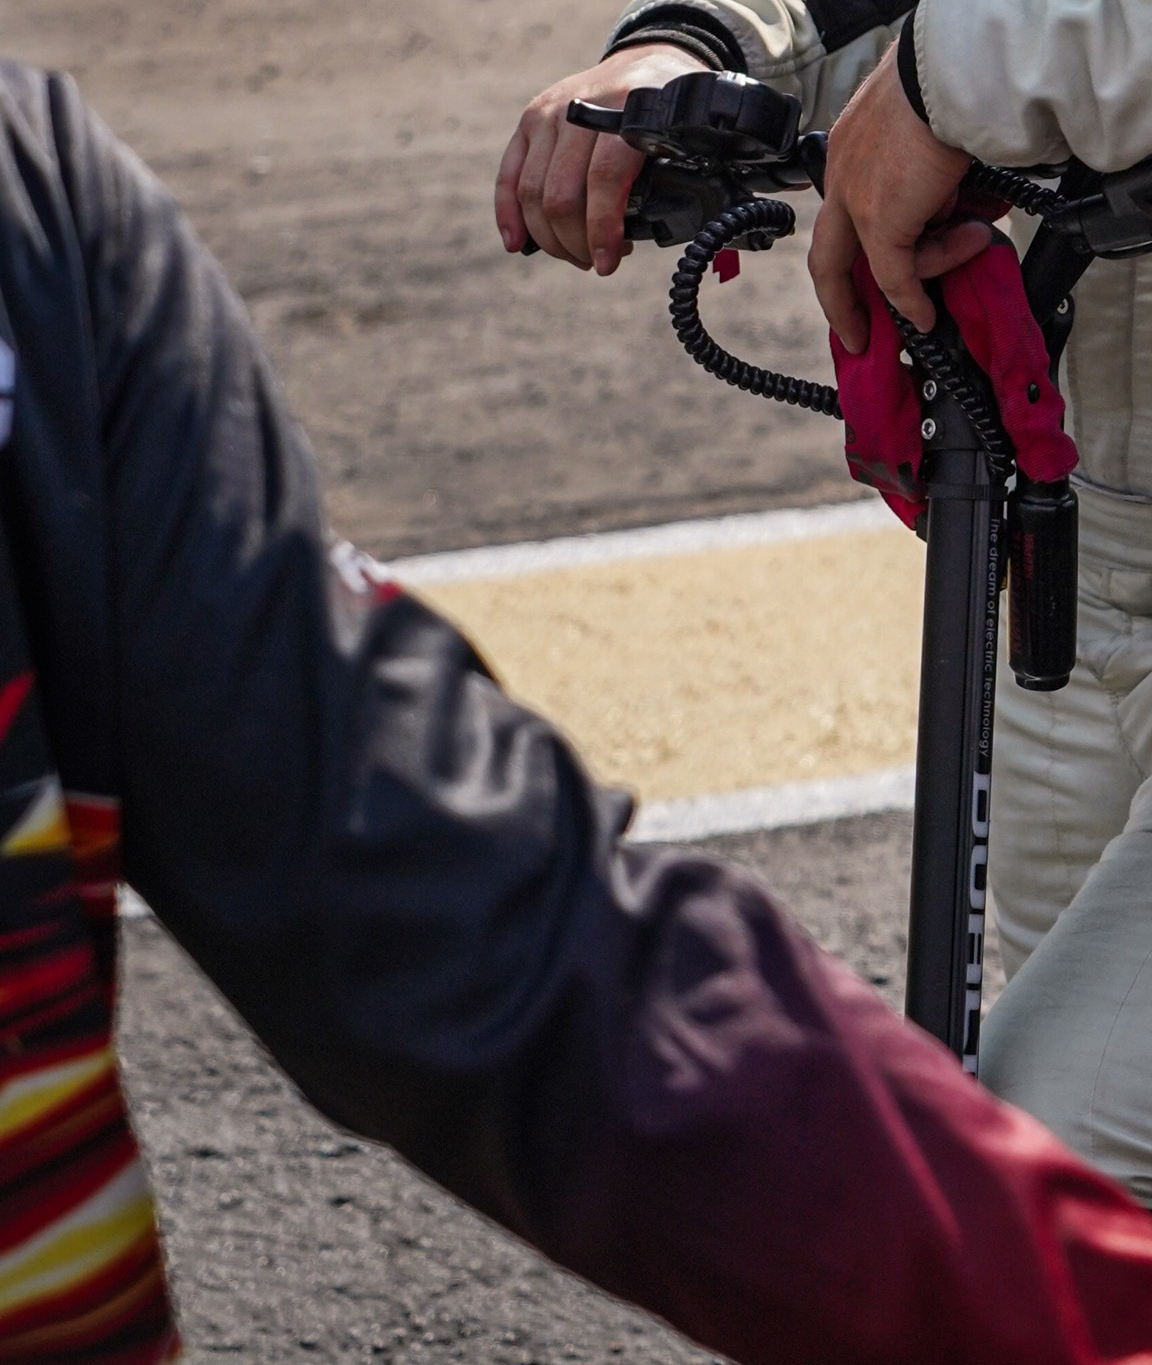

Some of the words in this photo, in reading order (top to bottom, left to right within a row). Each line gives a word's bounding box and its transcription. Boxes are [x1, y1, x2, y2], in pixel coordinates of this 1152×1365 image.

[987, 547, 999, 597] dream
[986, 600, 997, 614] of
[984, 618, 995, 672] electric
[979, 677, 993, 758] technology
